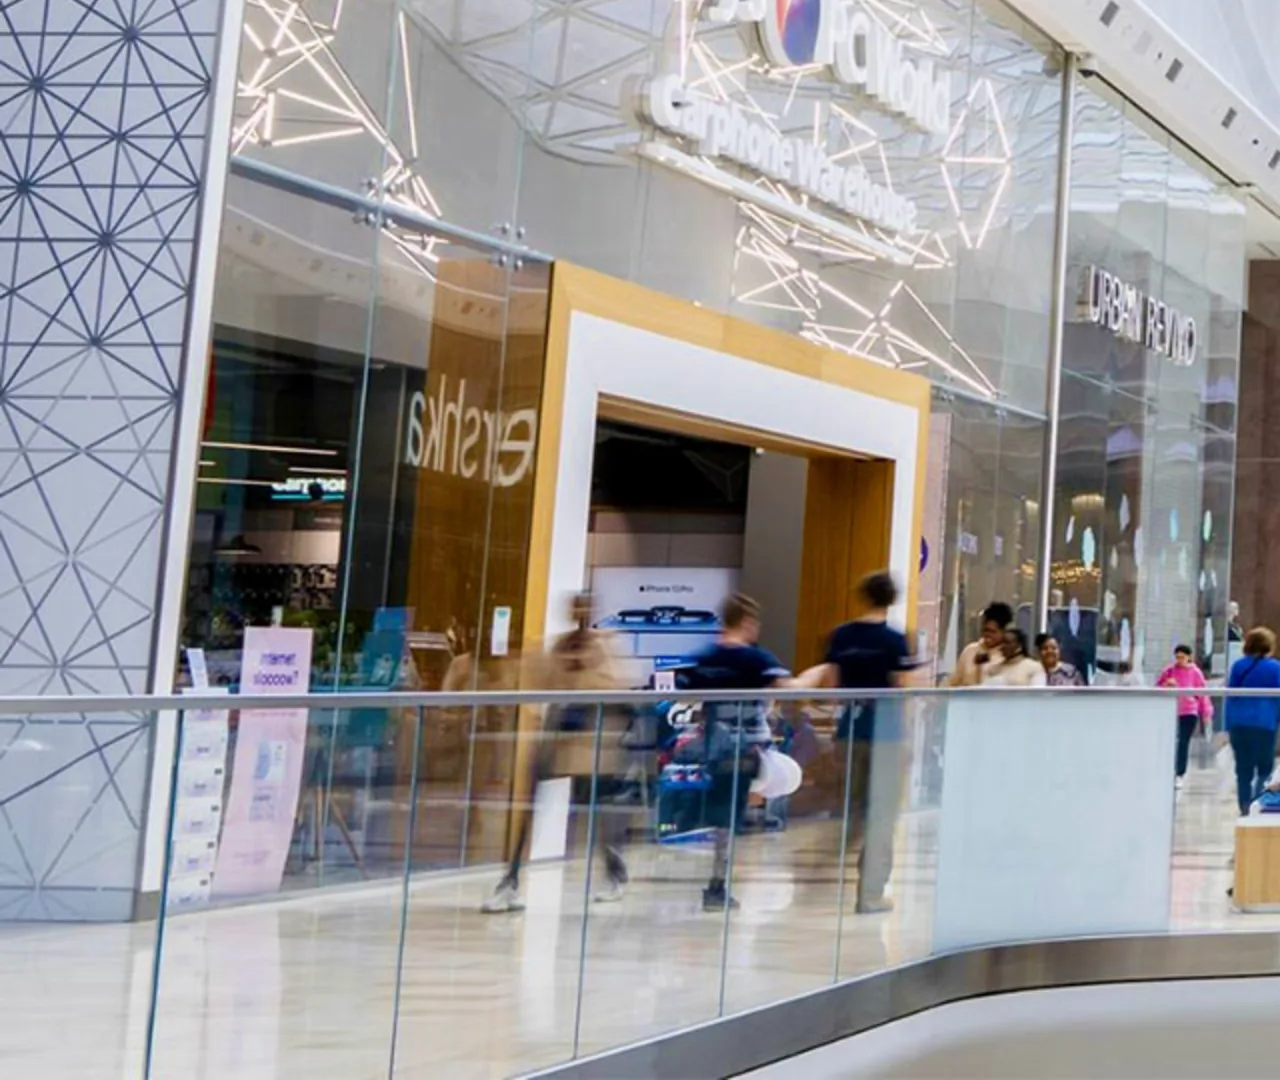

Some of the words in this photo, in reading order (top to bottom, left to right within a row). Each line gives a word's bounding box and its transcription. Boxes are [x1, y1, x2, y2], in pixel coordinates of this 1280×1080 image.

[866, 18, 952, 134] World
[648, 73, 796, 185] Carphone
[795, 135, 919, 234] Warehouse
[1089, 264, 1143, 343] URBAN
